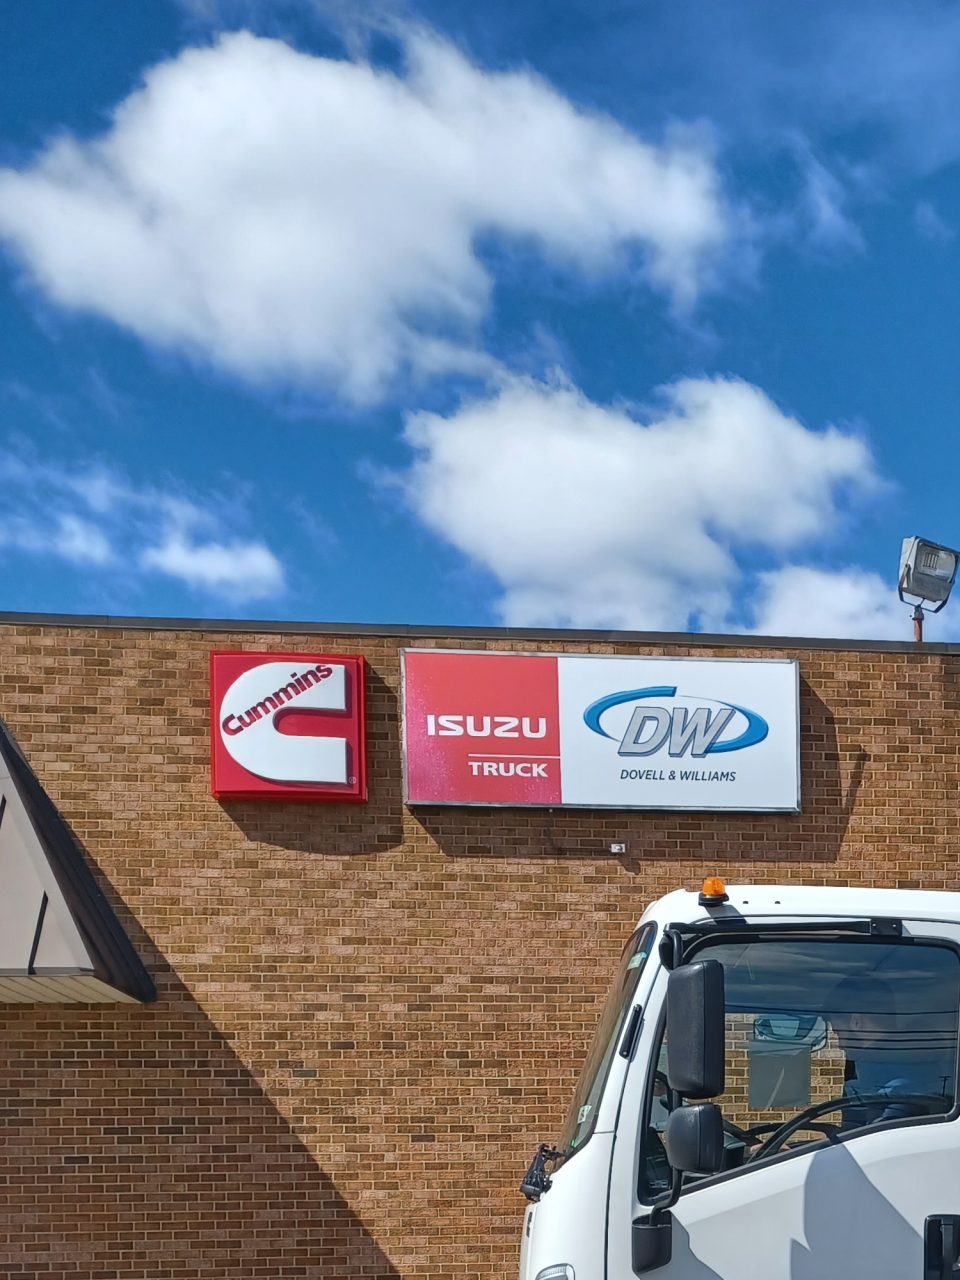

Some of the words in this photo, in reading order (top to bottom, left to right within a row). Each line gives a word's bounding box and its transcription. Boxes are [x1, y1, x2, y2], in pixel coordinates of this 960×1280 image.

[222, 664, 334, 736] Cummins
[426, 714, 547, 739] ISUZU
[617, 706, 737, 759] DW
[467, 761, 549, 778] TRUCK
[620, 768, 666, 781] DOVELL
[668, 769, 677, 781] &
[679, 770, 737, 782] WILLIAMS
